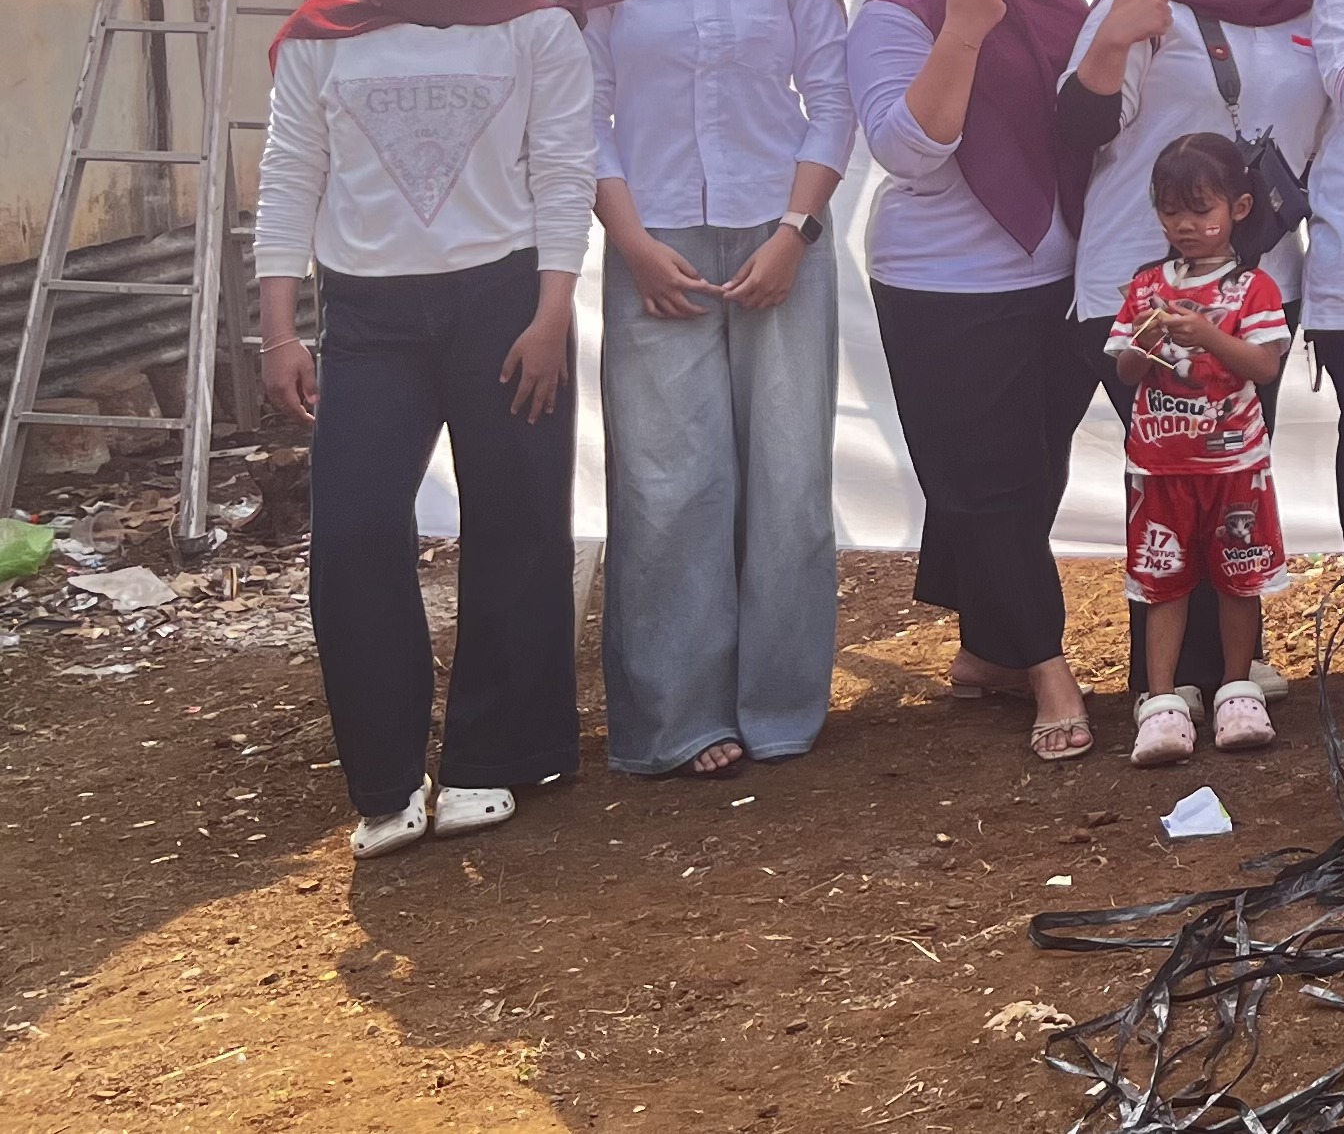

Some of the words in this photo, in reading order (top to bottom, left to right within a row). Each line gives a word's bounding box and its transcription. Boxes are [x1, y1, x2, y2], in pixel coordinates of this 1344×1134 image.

[366, 85, 491, 114] GUESS
[1148, 390, 1206, 416] kicau
[1149, 529, 1172, 549] 17
[1224, 547, 1263, 561] kicau
